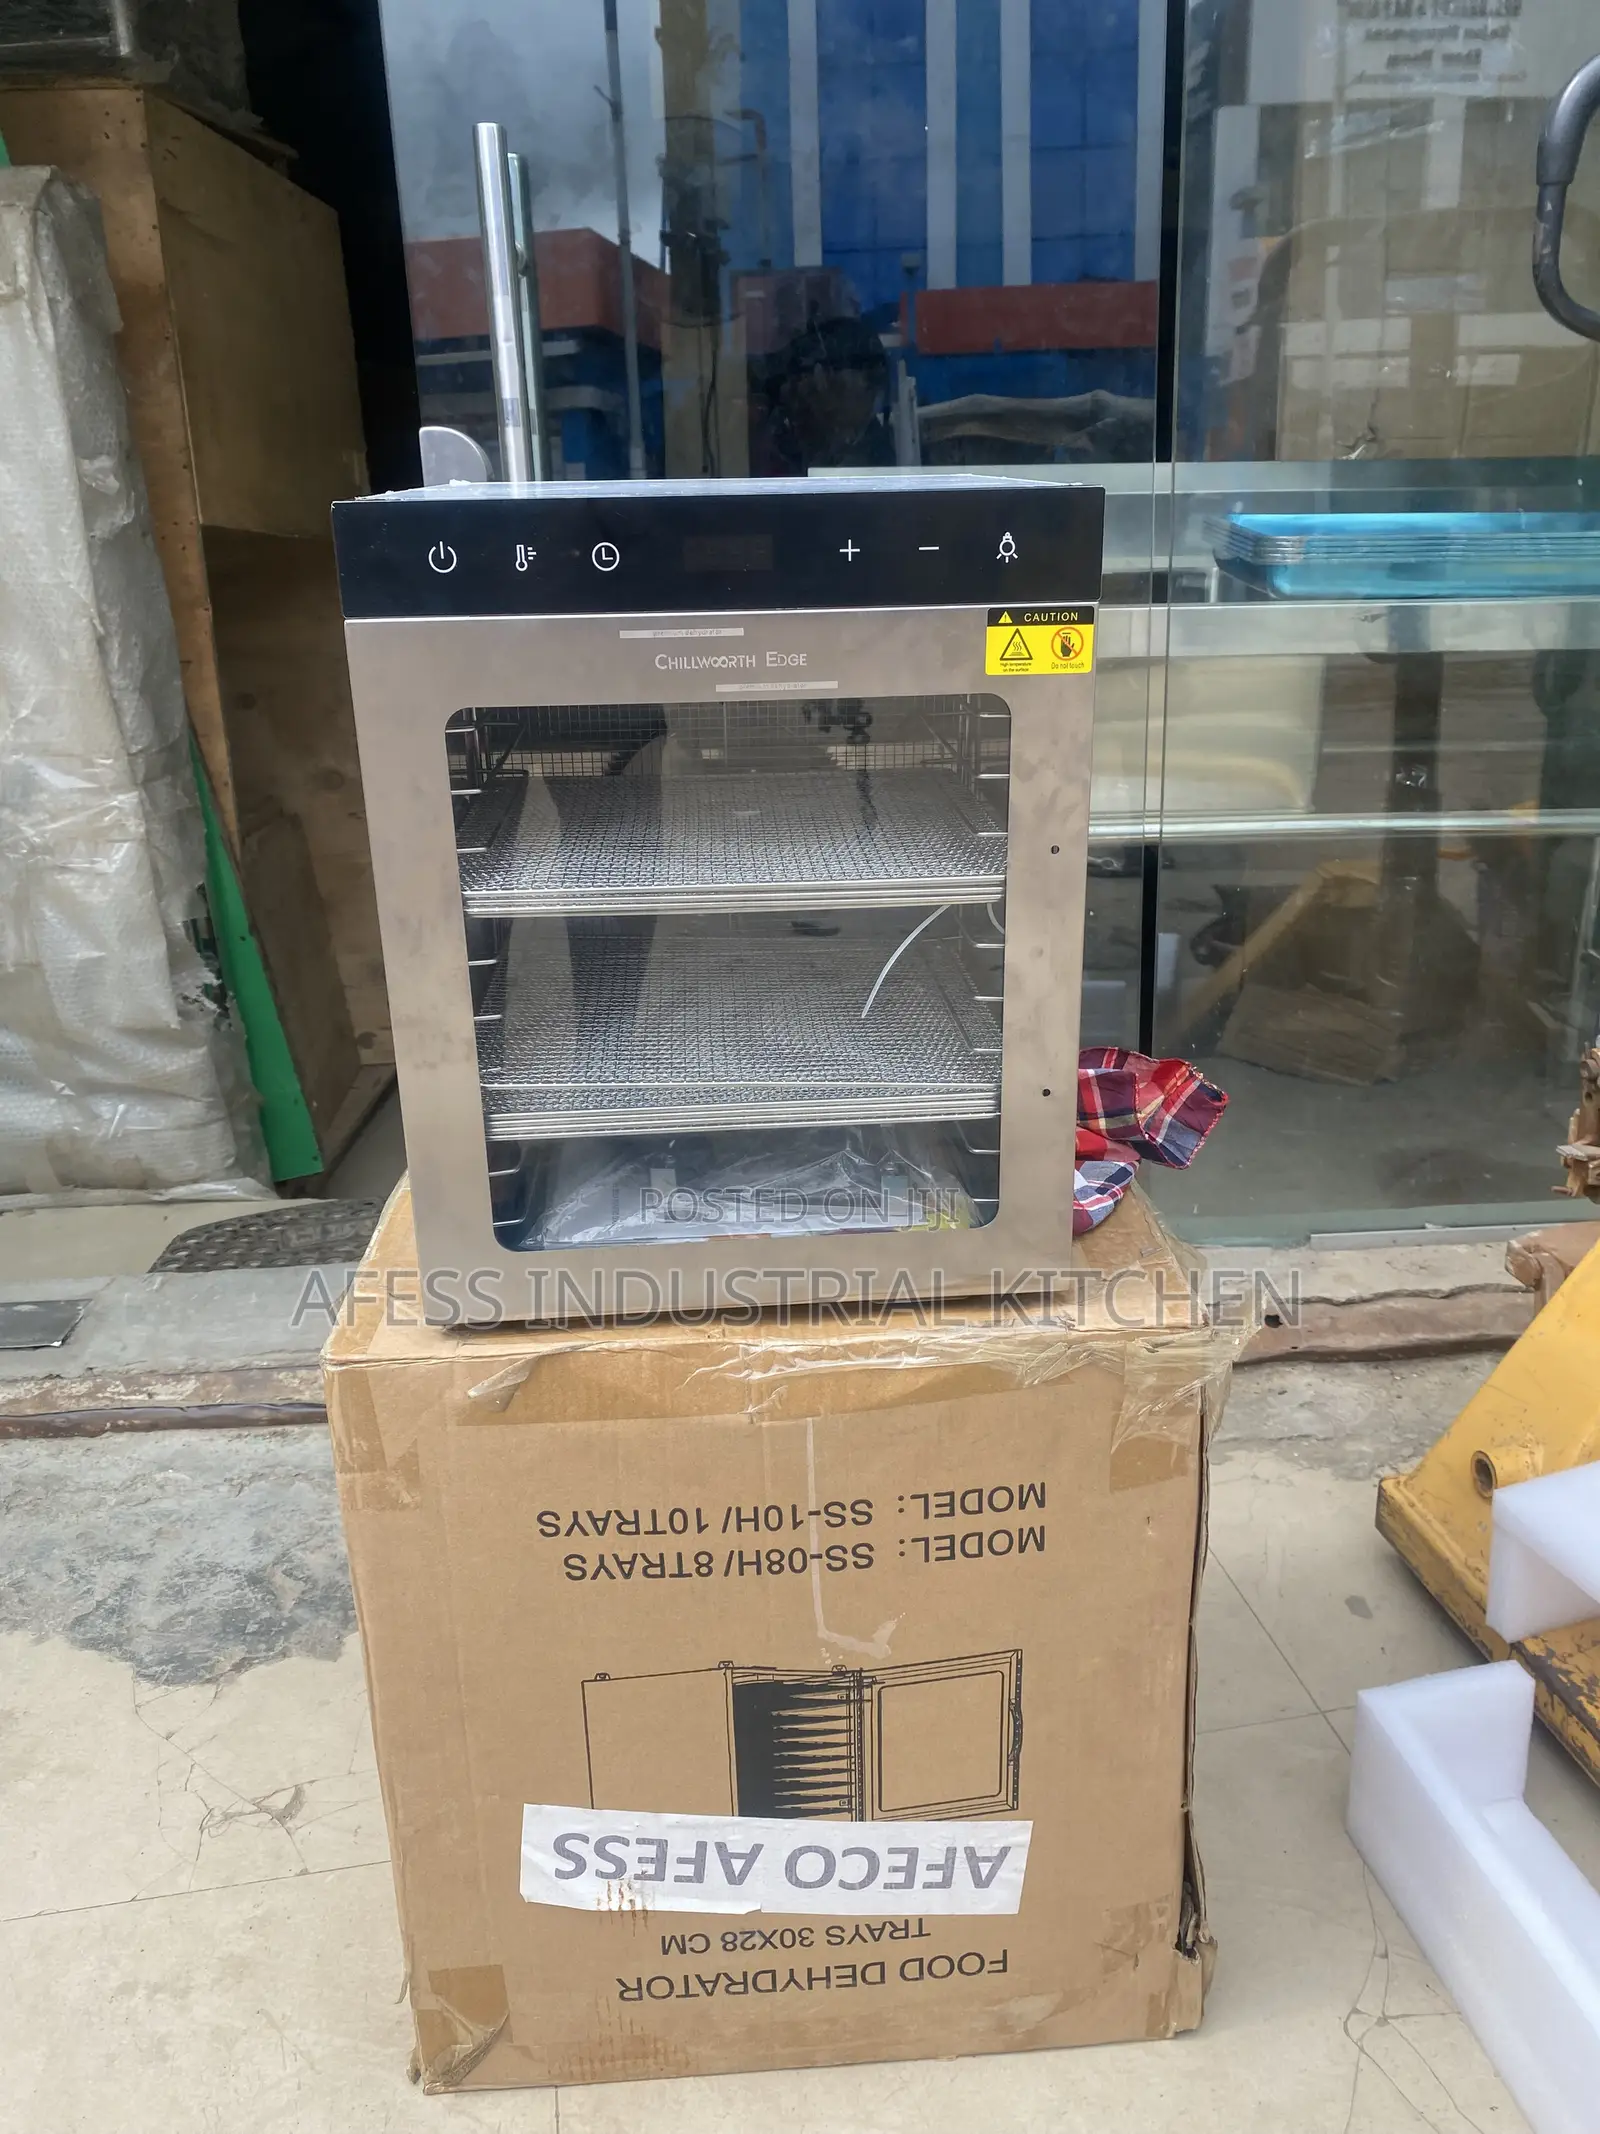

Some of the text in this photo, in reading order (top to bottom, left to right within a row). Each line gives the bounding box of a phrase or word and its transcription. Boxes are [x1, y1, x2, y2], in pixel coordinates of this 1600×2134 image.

[1024, 611, 1079, 622] CAUTION
[536, 1482, 1046, 1538] MODEL: SS-10H/ 10TRAYS
[563, 1525, 1046, 1581] MODEL: SS-08H/ 8TRAYS
[552, 1832, 1012, 1890] AFECO AFESS
[661, 1917, 931, 1955] TRAYS 30X28 CM
[616, 1949, 1008, 2001] FOOD DEHYDRATOR
